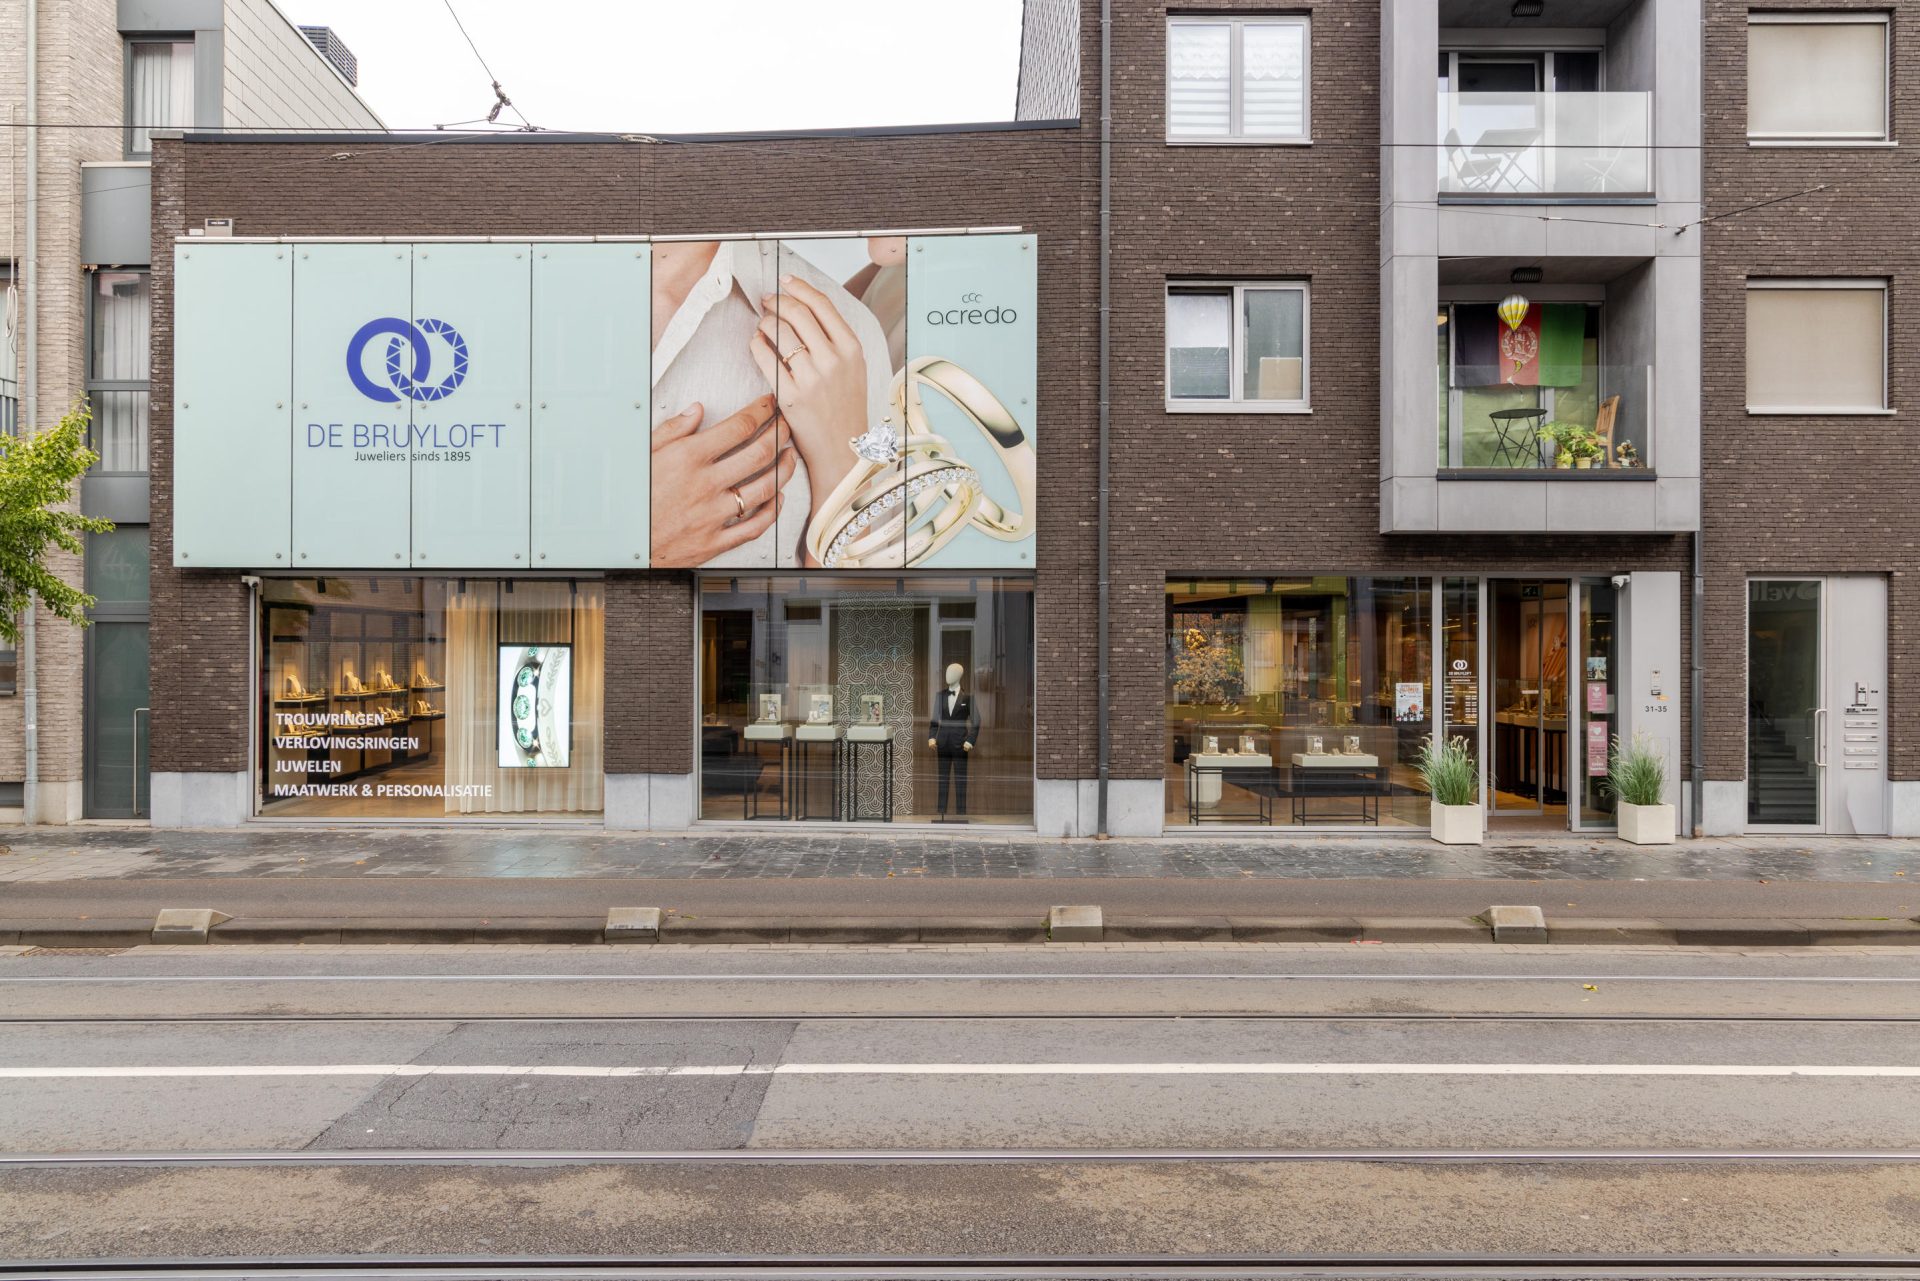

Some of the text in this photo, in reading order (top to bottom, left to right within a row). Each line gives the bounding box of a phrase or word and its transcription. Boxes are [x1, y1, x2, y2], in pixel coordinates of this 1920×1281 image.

[927, 306, 1017, 325] acredo
[308, 424, 506, 448] DE BRUYLOFT
[355, 451, 471, 462] Juweliers sinds 1895
[1645, 705, 1668, 713] 31-35
[275, 713, 385, 726] TROUWRINGEN
[275, 737, 419, 750] VERLOVINGSRINGEN
[275, 760, 342, 773] JUWELEN
[274, 784, 492, 797] MAATWERK & PERSONALISATIE
